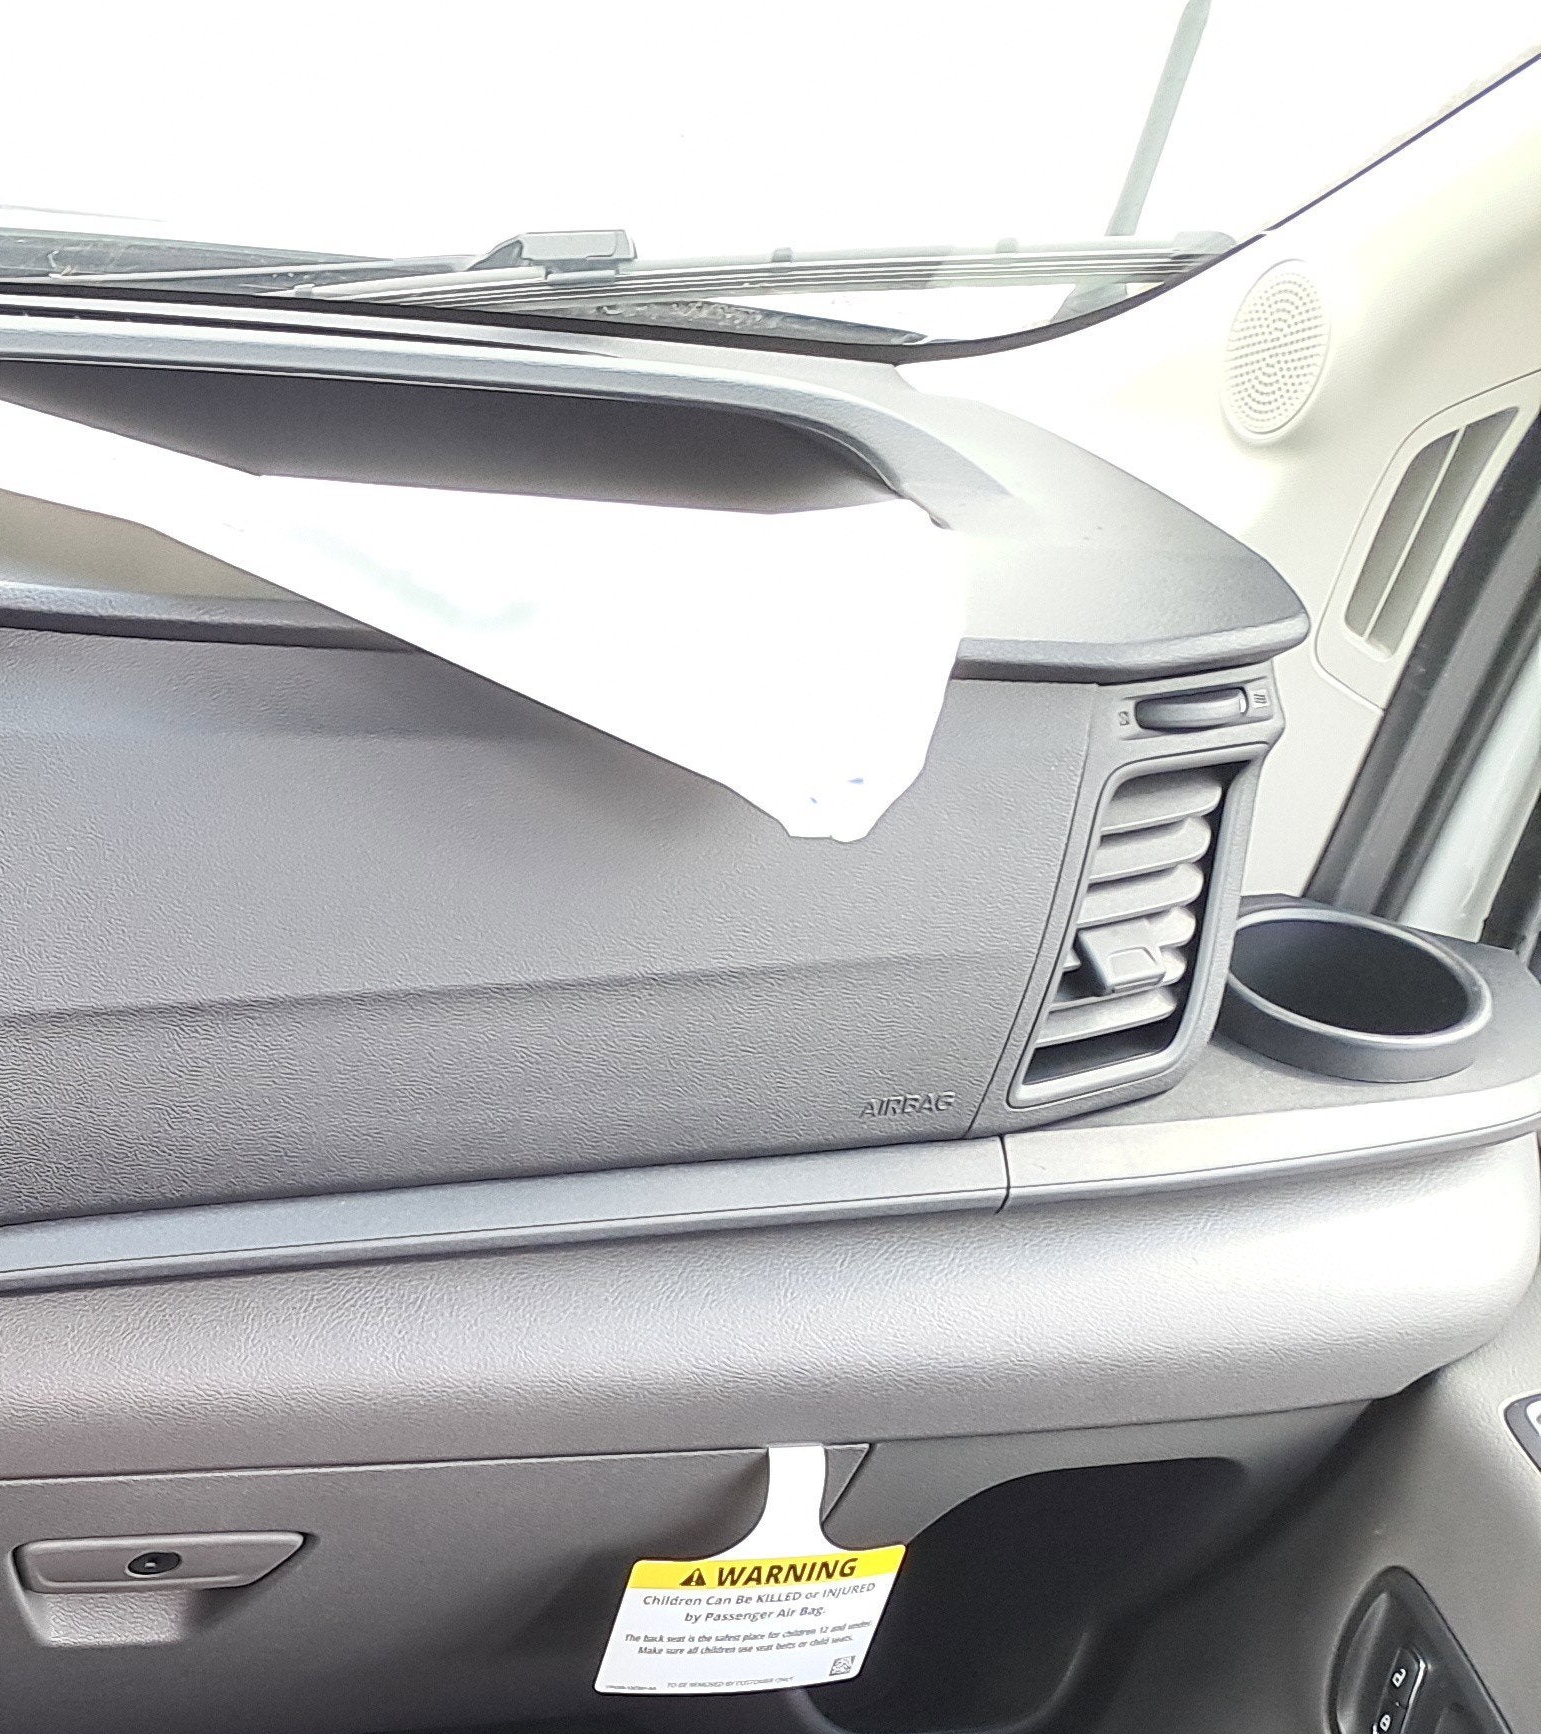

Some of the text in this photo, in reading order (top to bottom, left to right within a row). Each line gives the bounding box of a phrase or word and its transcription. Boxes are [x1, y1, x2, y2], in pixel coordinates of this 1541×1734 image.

[859, 1090, 956, 1119] AIRBAG
[717, 1557, 859, 1587] WARNING
[642, 1582, 876, 1607] Children Can Be KILLED or INJURED
[684, 1605, 826, 1625] by Passenger Air Bag.
[625, 1633, 641, 1642] The
[643, 1634, 664, 1643] back
[666, 1635, 685, 1643] seat
[697, 1634, 713, 1643] the
[715, 1633, 742, 1642] safest
[742, 1632, 766, 1642] place
[768, 1631, 781, 1639] for
[782, 1628, 817, 1638] children
[830, 1623, 847, 1633] and
[637, 1646, 663, 1655] Make
[666, 1647, 685, 1655] sure
[686, 1646, 699, 1655] all
[700, 1645, 736, 1655] children
[738, 1645, 754, 1653] use
[755, 1644, 774, 1652] seat
